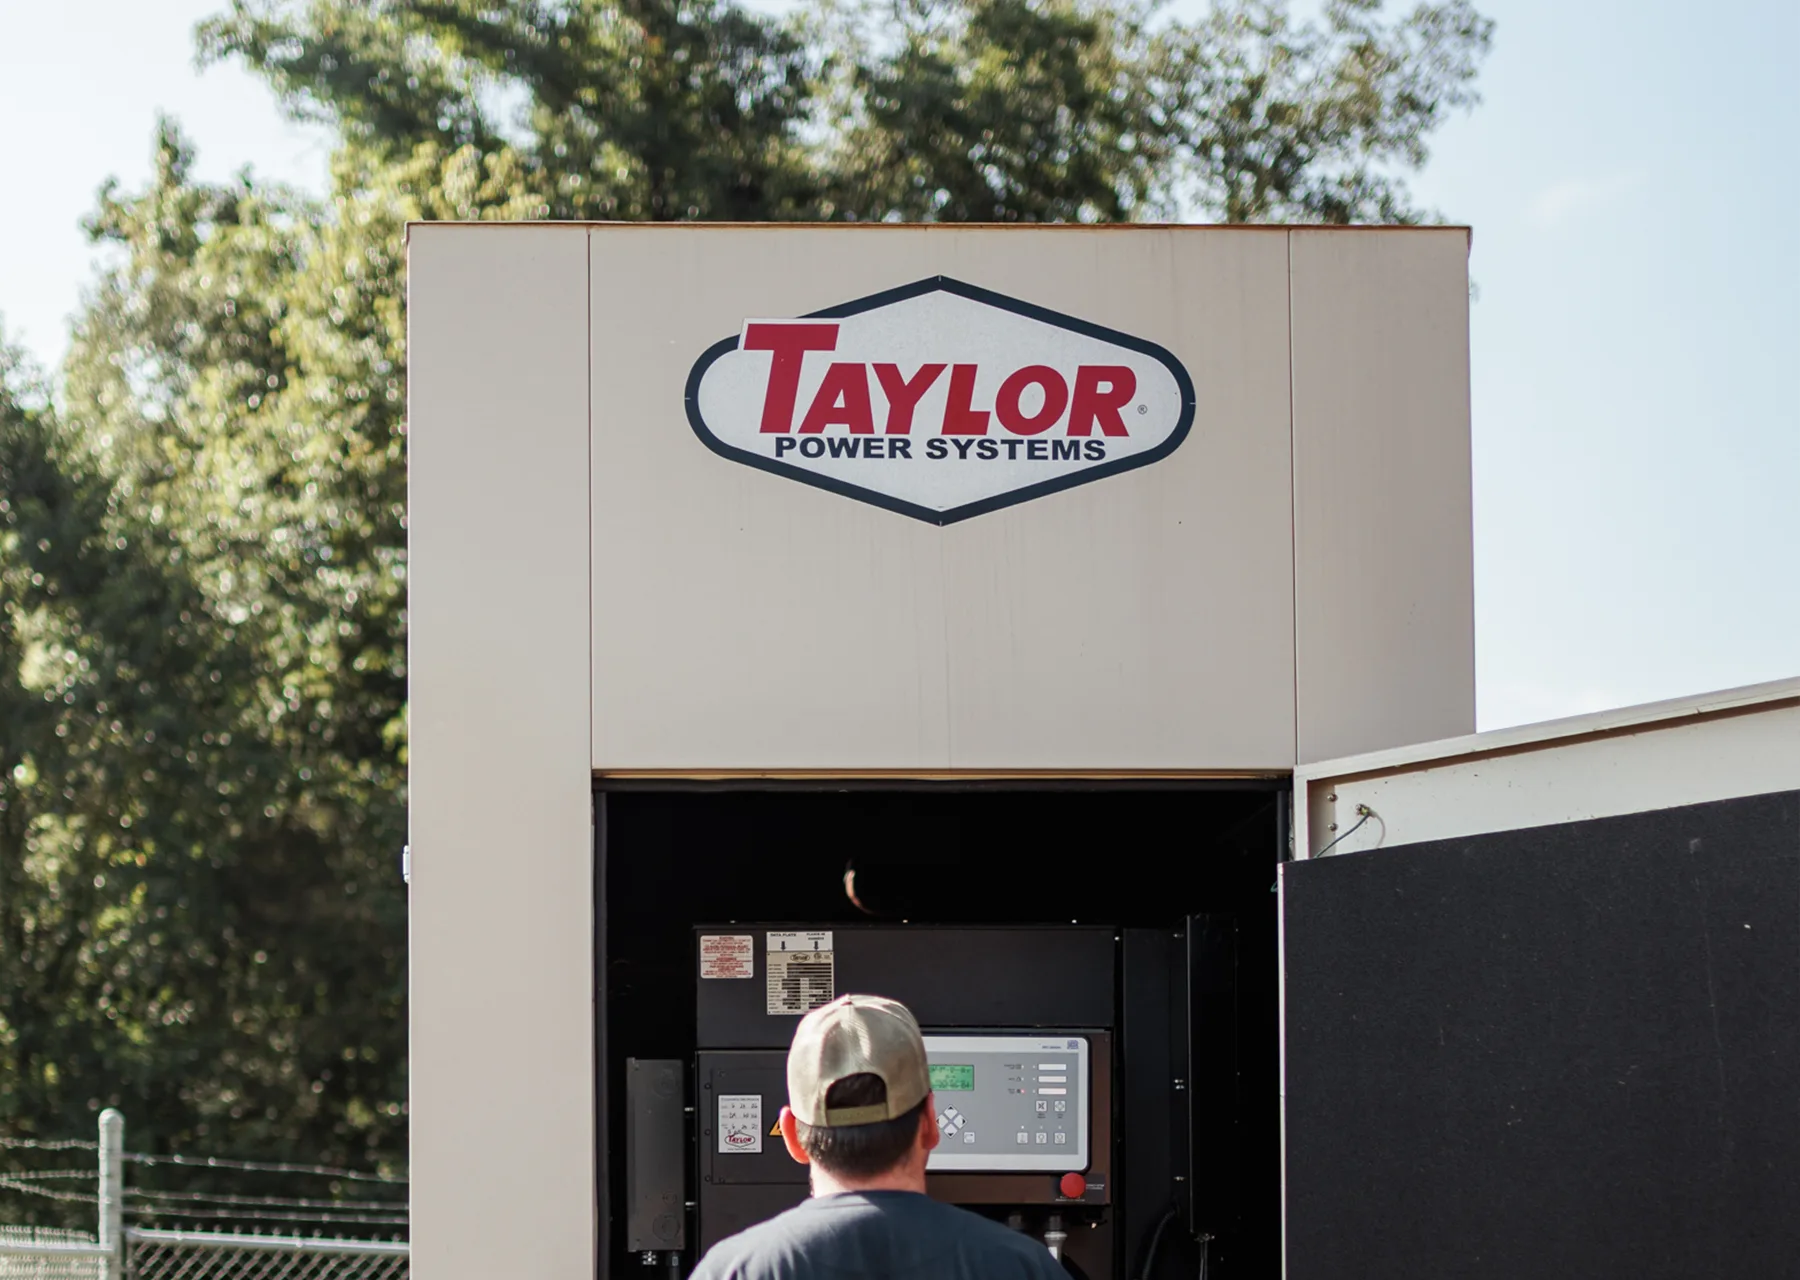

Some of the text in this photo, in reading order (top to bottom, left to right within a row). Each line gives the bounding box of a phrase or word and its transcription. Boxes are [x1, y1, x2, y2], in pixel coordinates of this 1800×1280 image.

[743, 324, 1137, 436] TAYLOR
[774, 437, 1107, 461] POWER SYSTEMS
